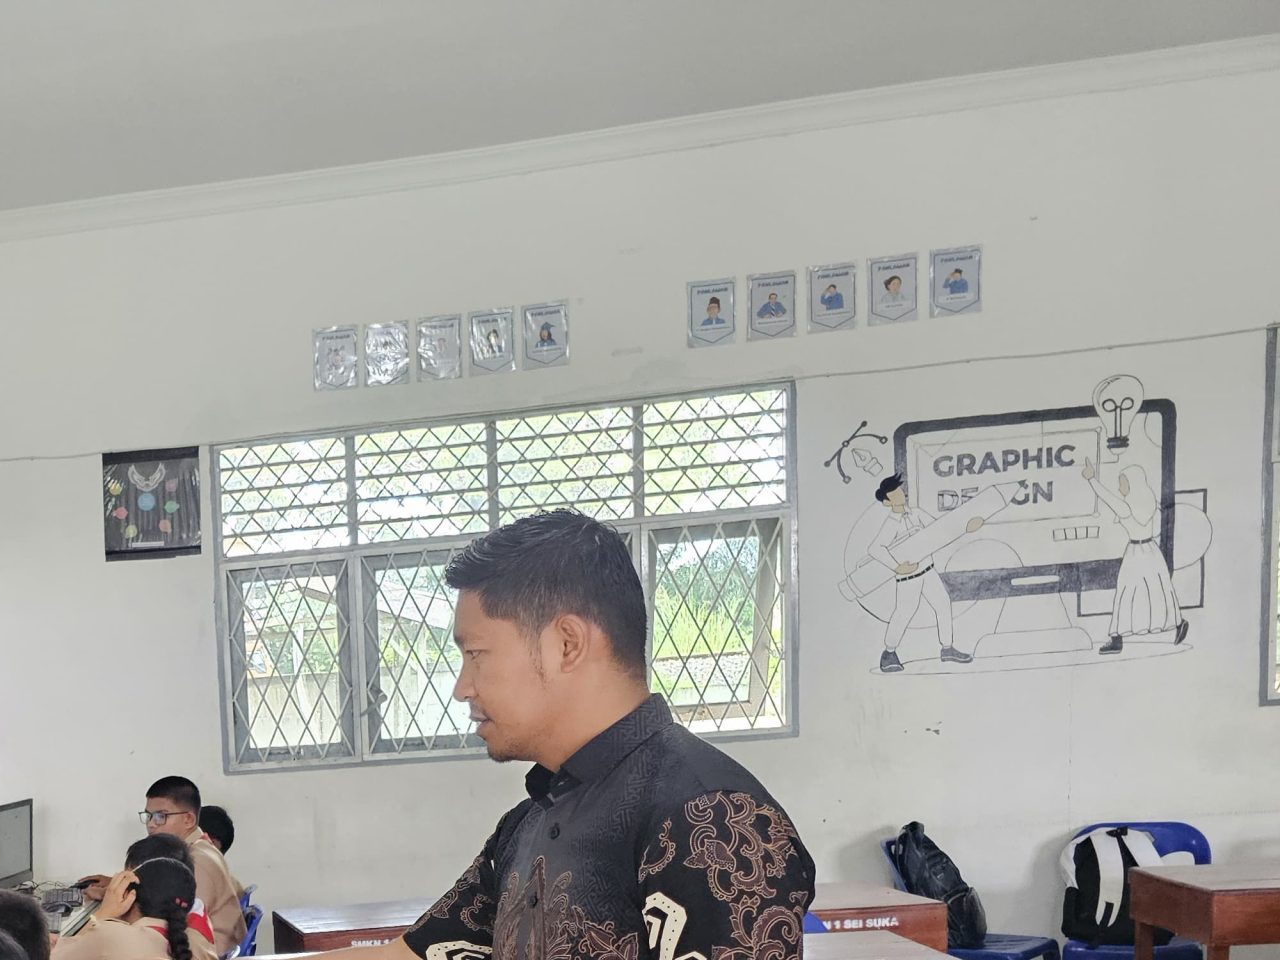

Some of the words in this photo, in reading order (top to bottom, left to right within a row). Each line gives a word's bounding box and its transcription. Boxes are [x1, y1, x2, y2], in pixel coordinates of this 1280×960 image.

[932, 444, 1076, 477] GRAPHIC
[937, 480, 1053, 512] DEGN
[843, 919, 861, 929] SEI
[865, 916, 899, 930] SUKA
